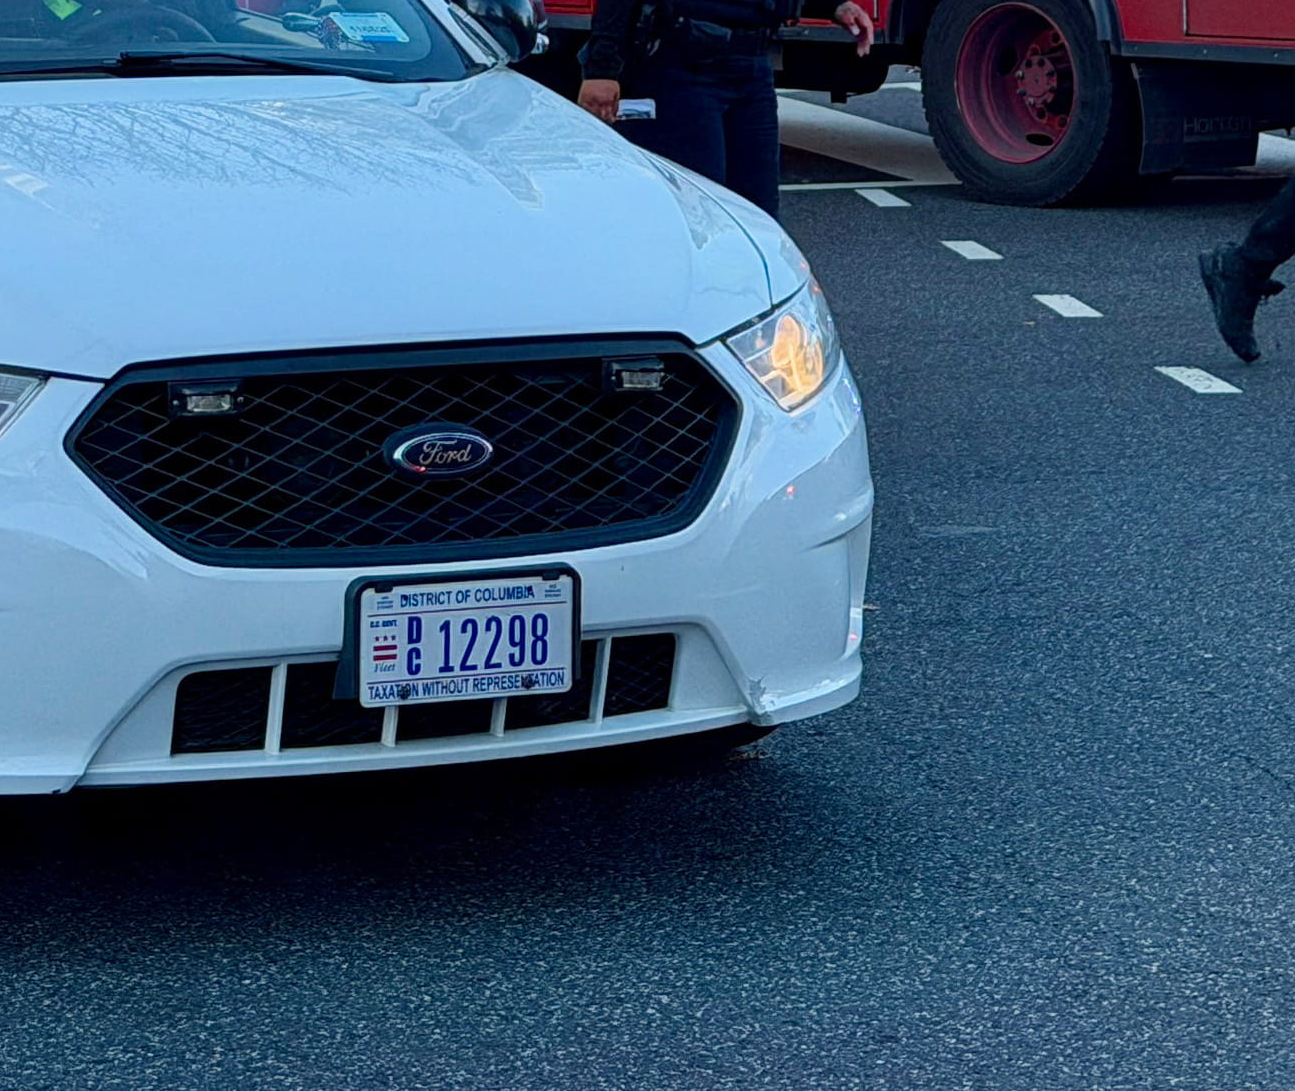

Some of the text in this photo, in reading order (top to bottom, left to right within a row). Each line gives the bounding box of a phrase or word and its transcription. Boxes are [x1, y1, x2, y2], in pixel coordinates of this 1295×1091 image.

[418, 439, 473, 466] Ford
[400, 590, 451, 608] DISTRICT
[455, 588, 471, 604] OF
[475, 585, 535, 602] COLUMBIA
[438, 613, 549, 674] 12298
[421, 678, 470, 696] WITHOUT
